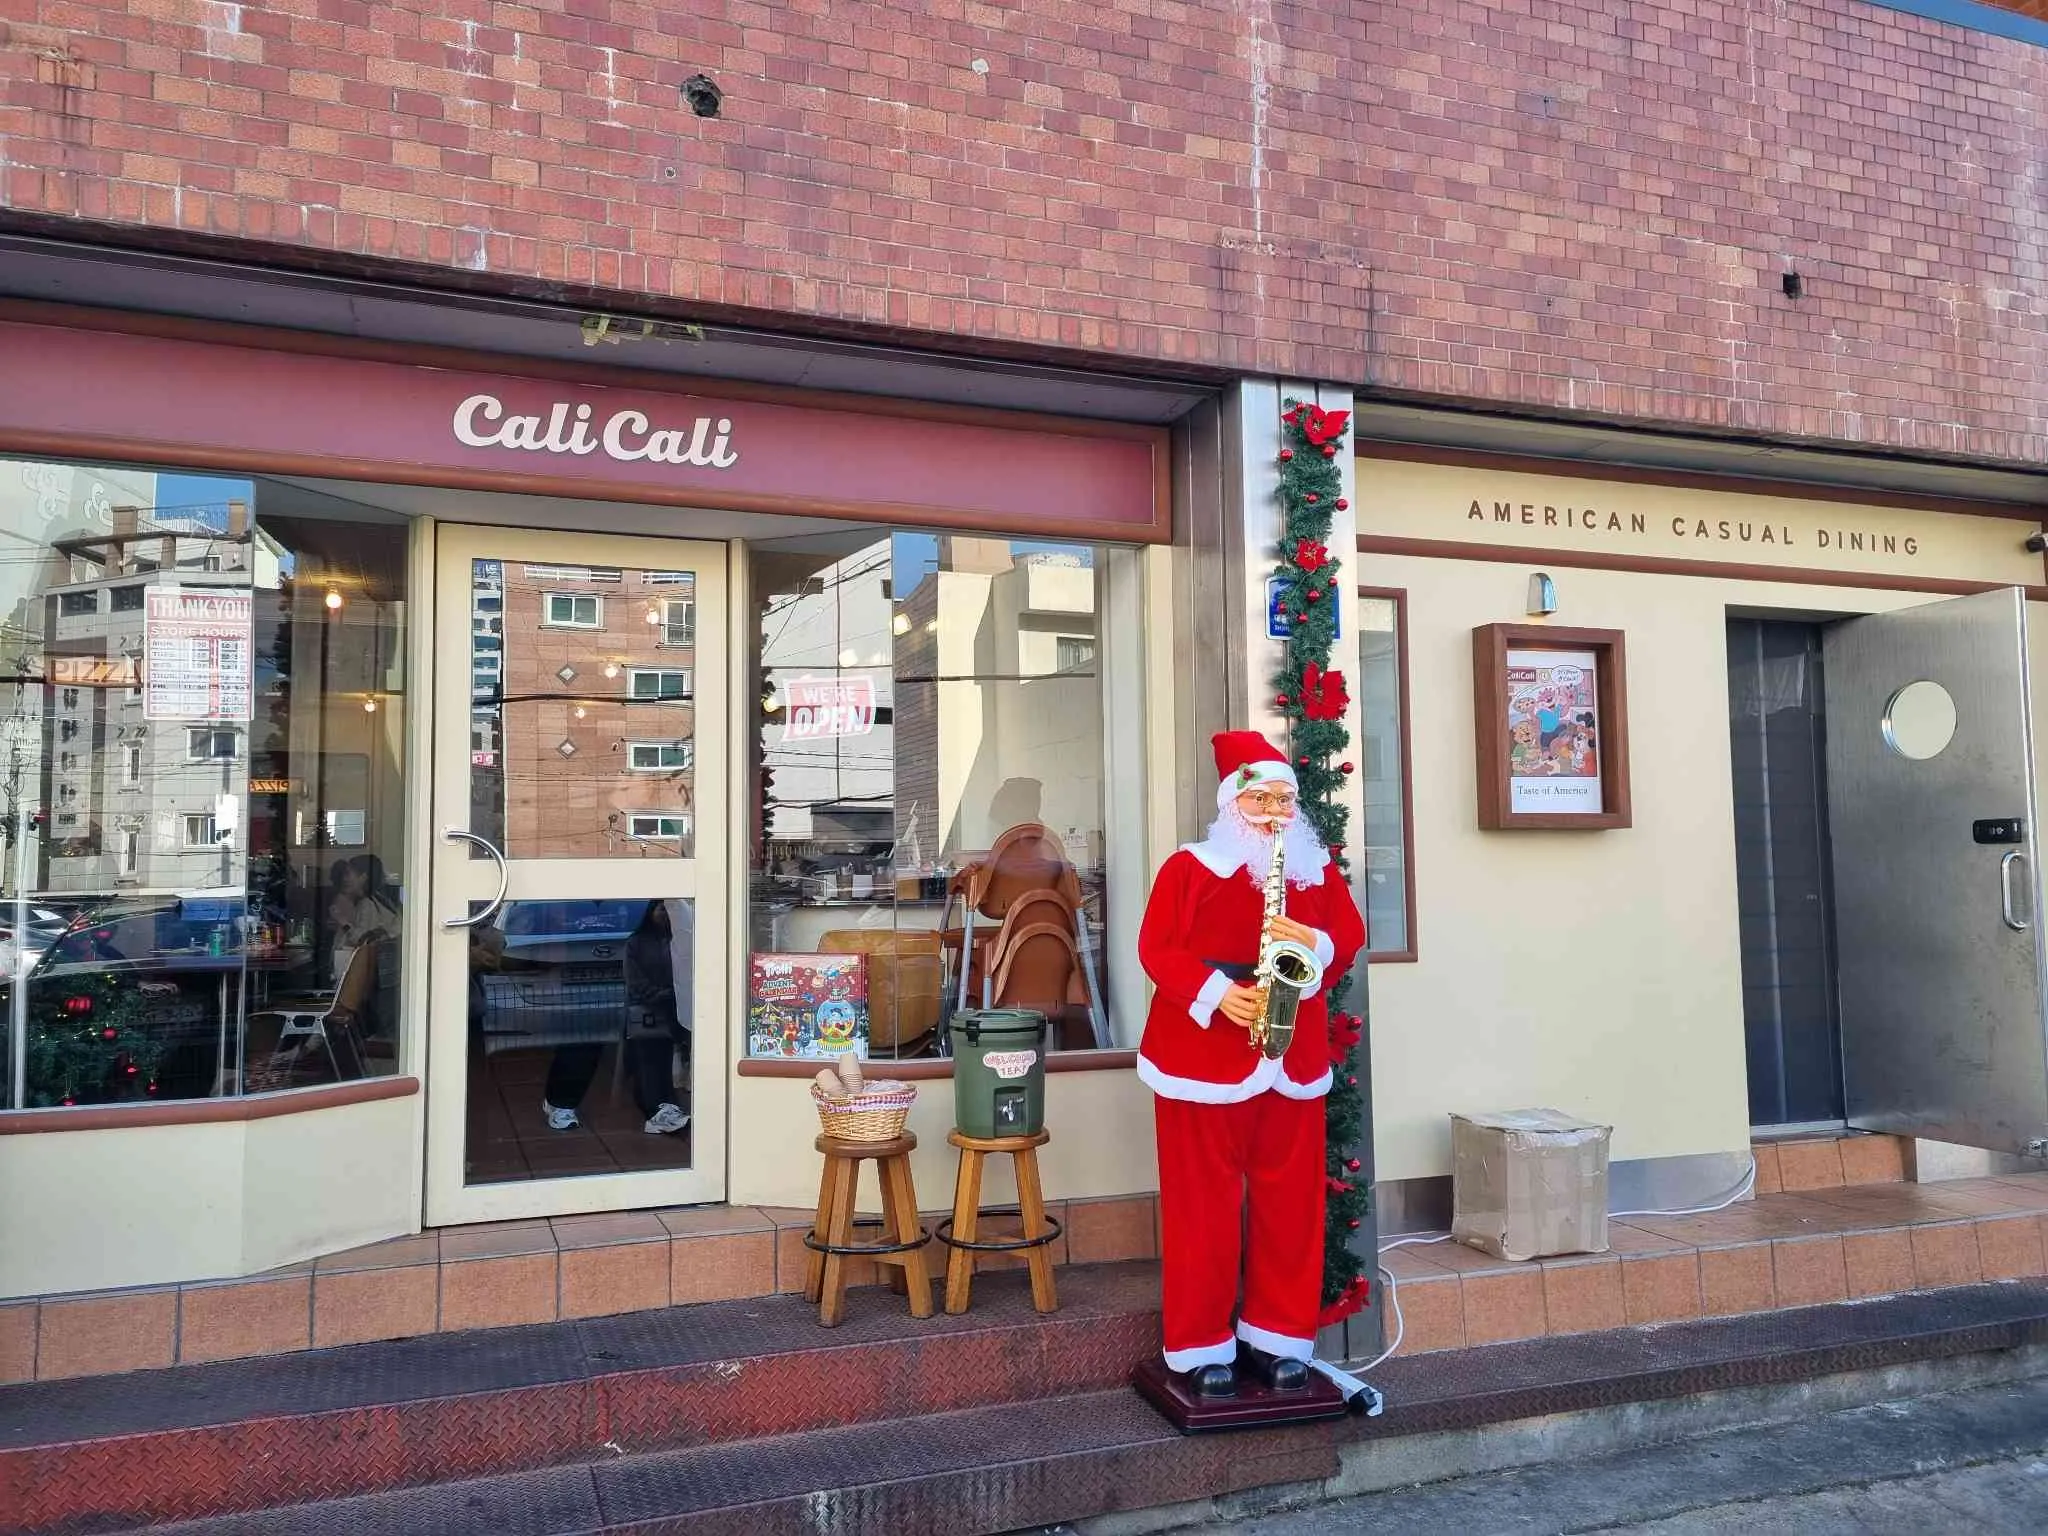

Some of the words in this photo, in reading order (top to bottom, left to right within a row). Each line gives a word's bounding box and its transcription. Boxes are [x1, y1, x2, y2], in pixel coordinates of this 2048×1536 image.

[1467, 500, 1646, 534] AMERICAN
[1671, 517, 1794, 546] CASUAL
[1817, 529, 1919, 556] DINING
[151, 597, 208, 618] THANK
[215, 599, 249, 620] YOU
[51, 659, 143, 684] PIZZA
[794, 705, 867, 736] OPEN
[1517, 784, 1539, 796] Taste
[1553, 785, 1589, 796] America
